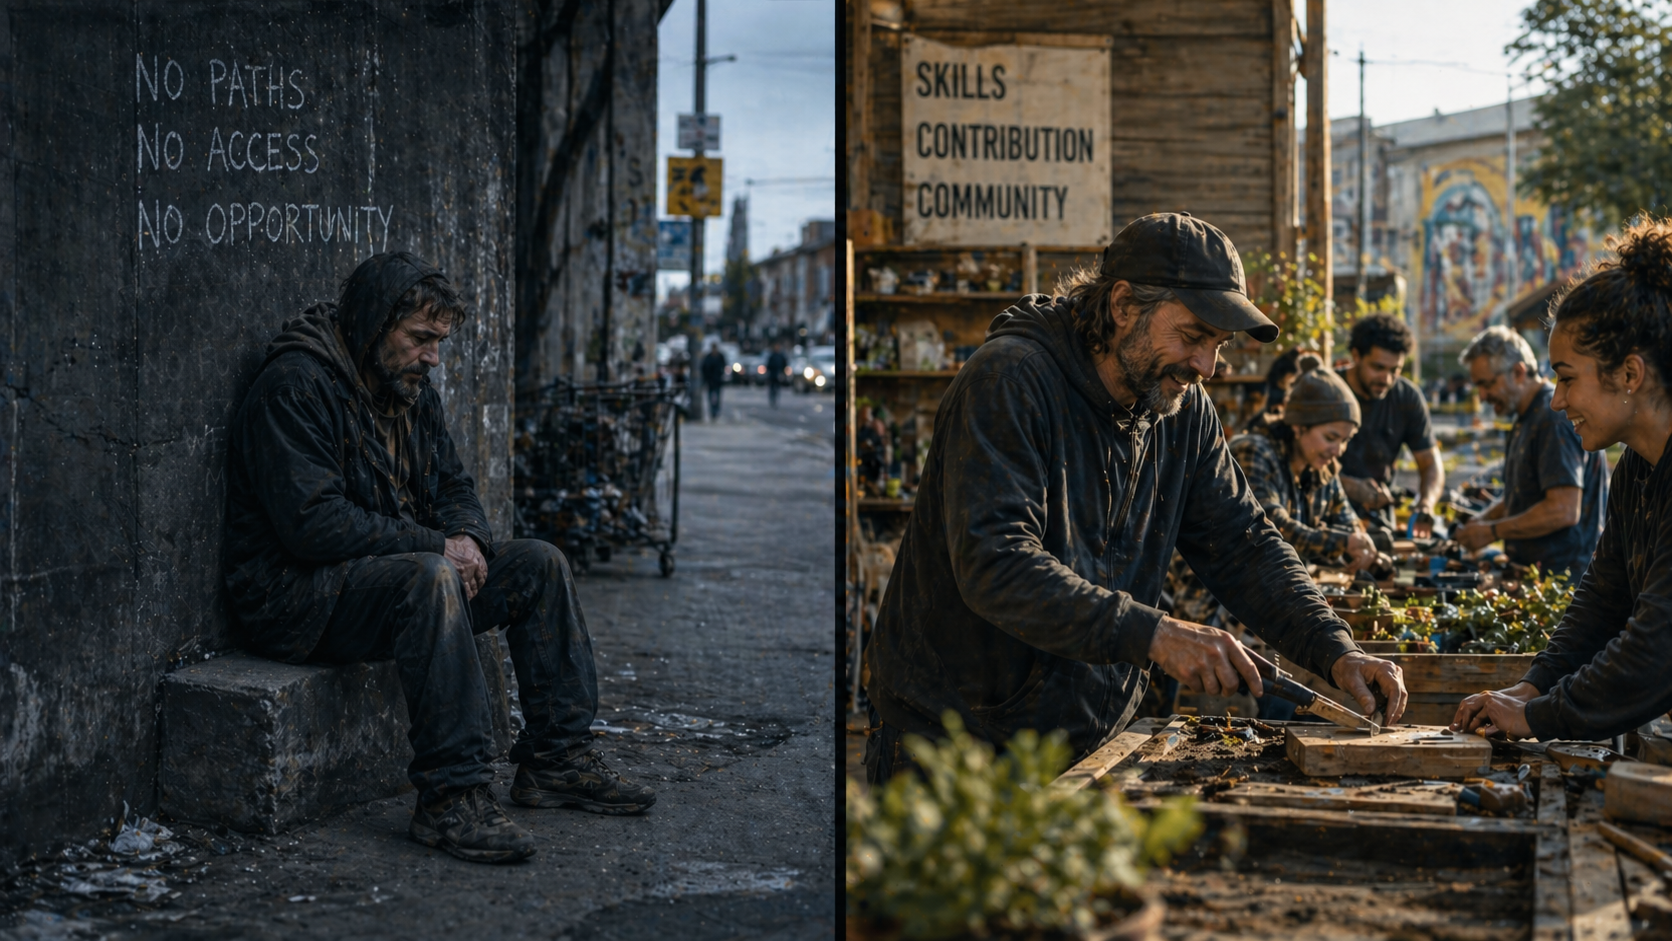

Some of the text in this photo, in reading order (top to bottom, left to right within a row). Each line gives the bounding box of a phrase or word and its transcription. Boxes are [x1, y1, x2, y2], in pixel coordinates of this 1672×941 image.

[136, 53, 305, 110] NO PATHS
[916, 61, 1007, 101] SKILLS
[137, 123, 320, 174] NO ACCESS
[916, 121, 1094, 164] CONTRIBUTION
[917, 181, 1069, 221] COMMUNITY
[138, 200, 394, 255] NO OPPORTUNITY
